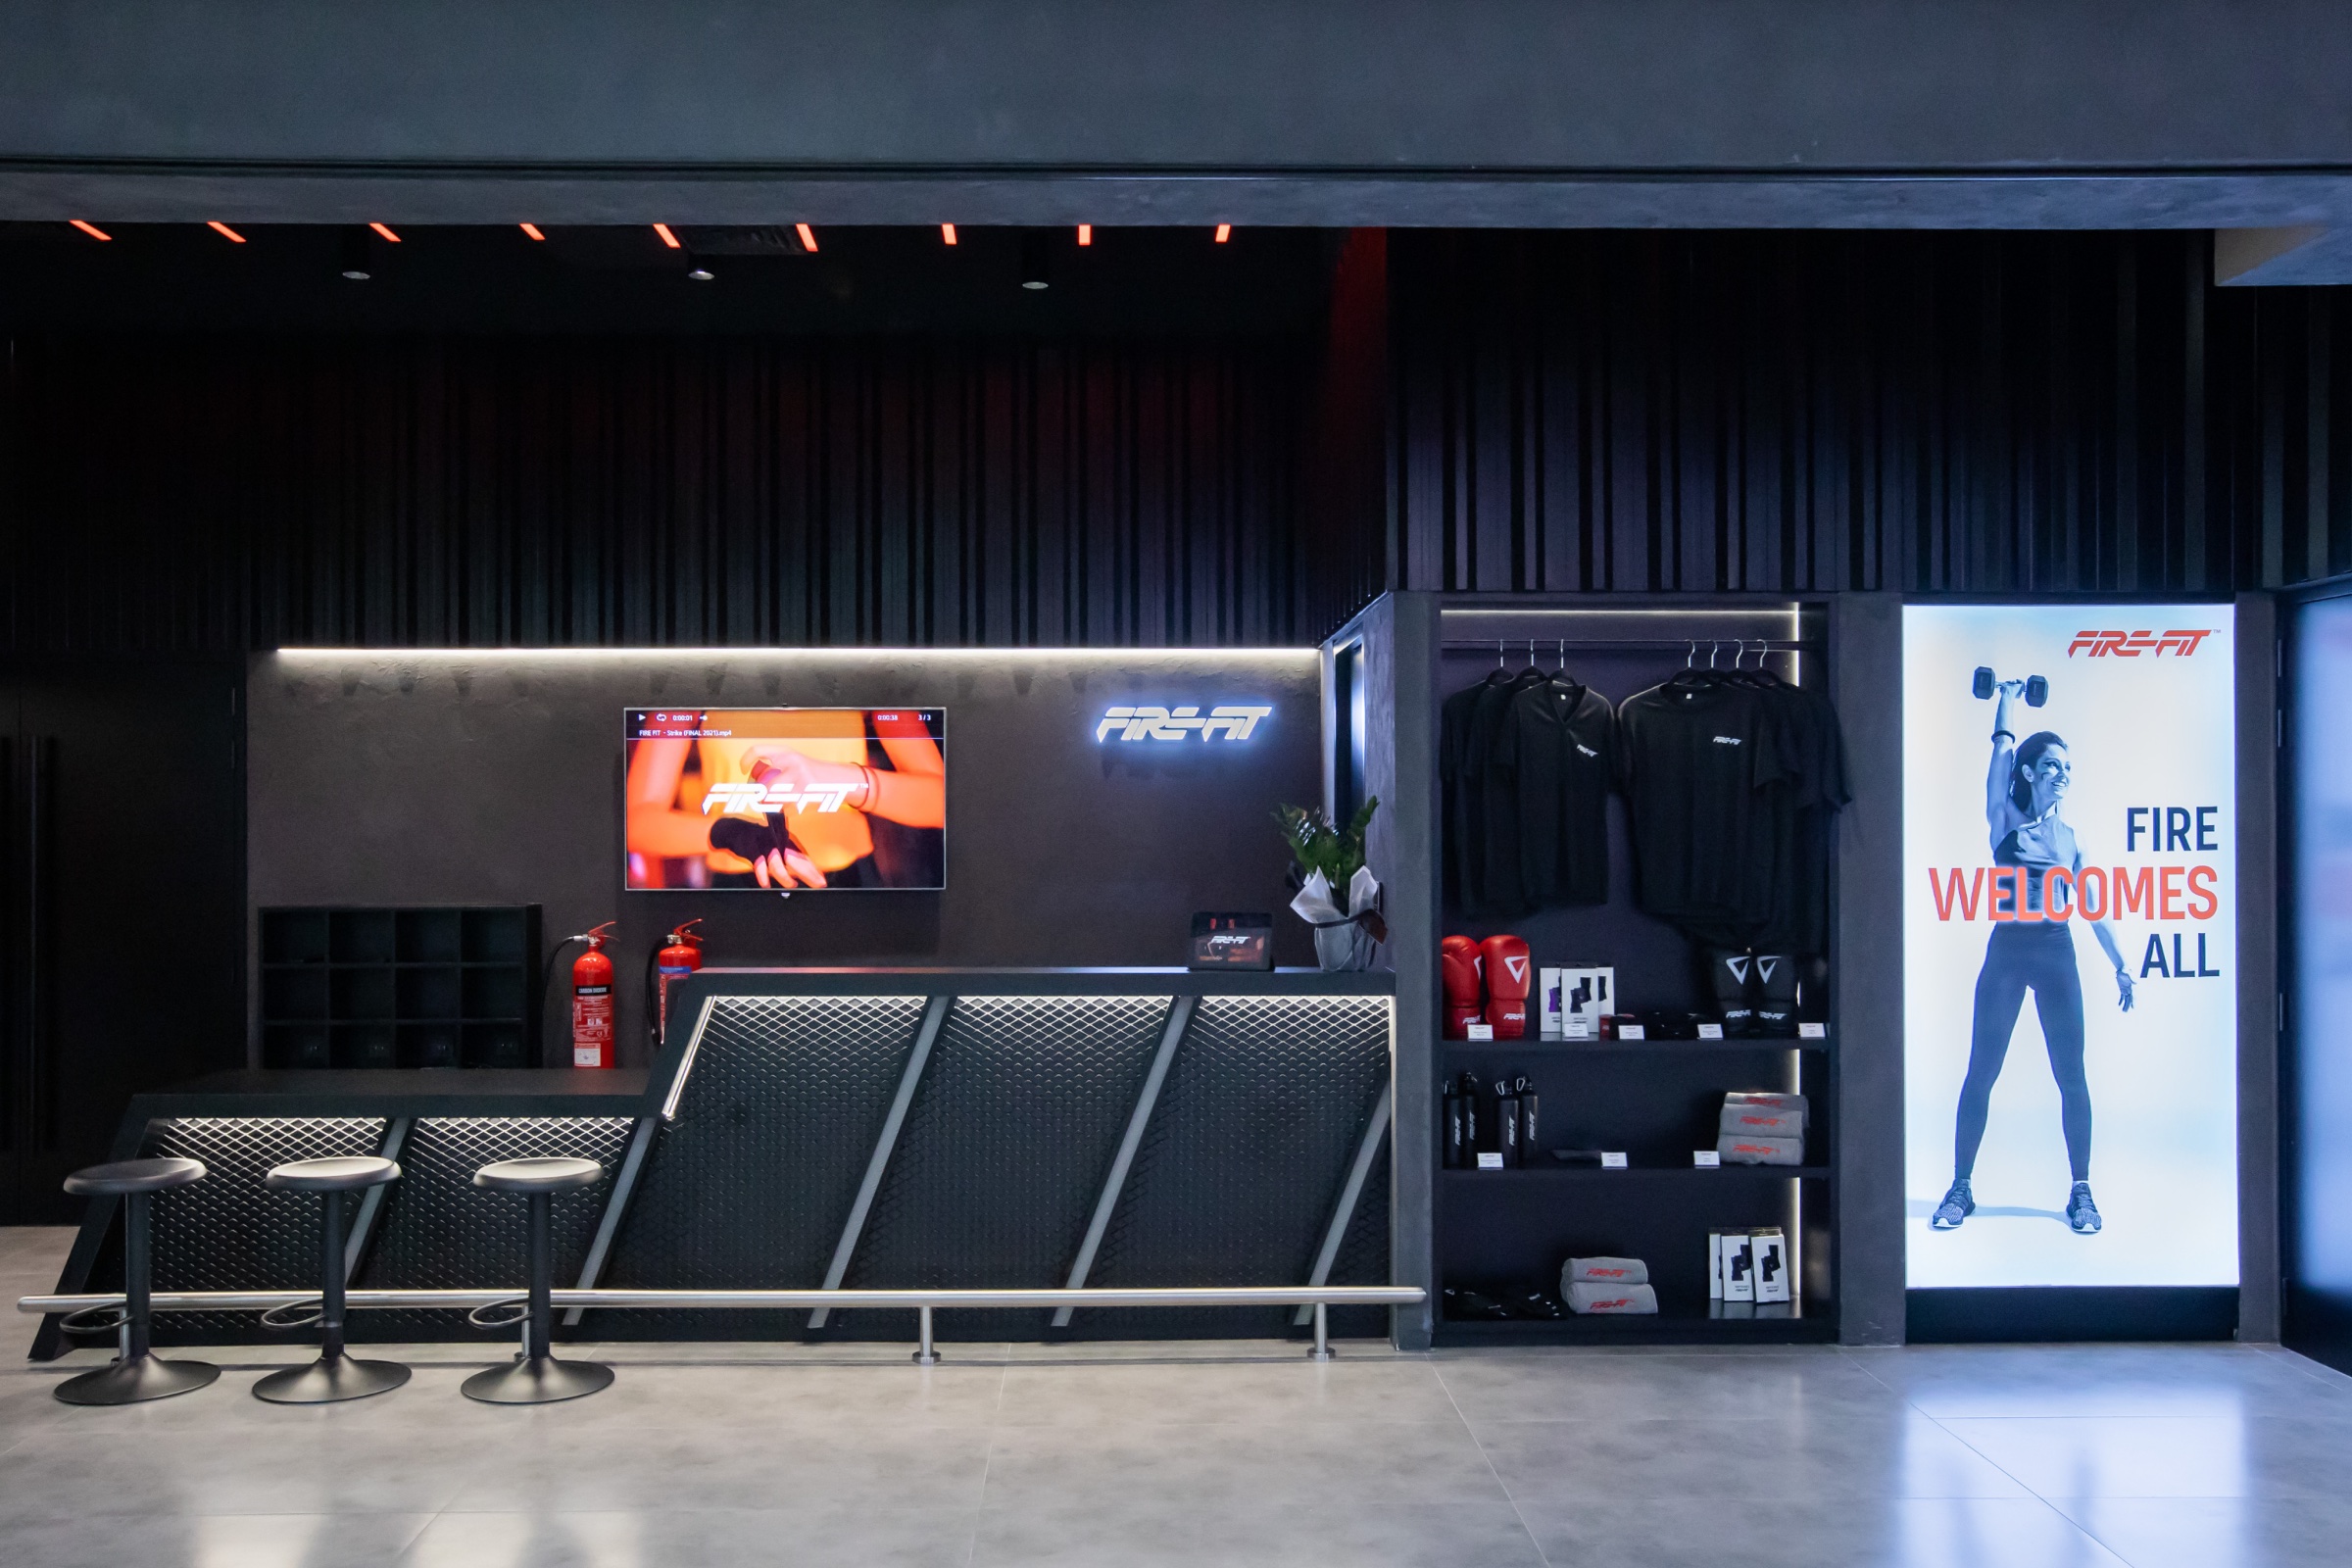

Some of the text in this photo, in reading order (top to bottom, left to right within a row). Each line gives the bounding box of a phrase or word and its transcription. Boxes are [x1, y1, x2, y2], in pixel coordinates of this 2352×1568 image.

[2128, 806, 2218, 852] FIRE
[1928, 865, 2218, 921] WELCOMES
[2140, 933, 2220, 978] ALL
